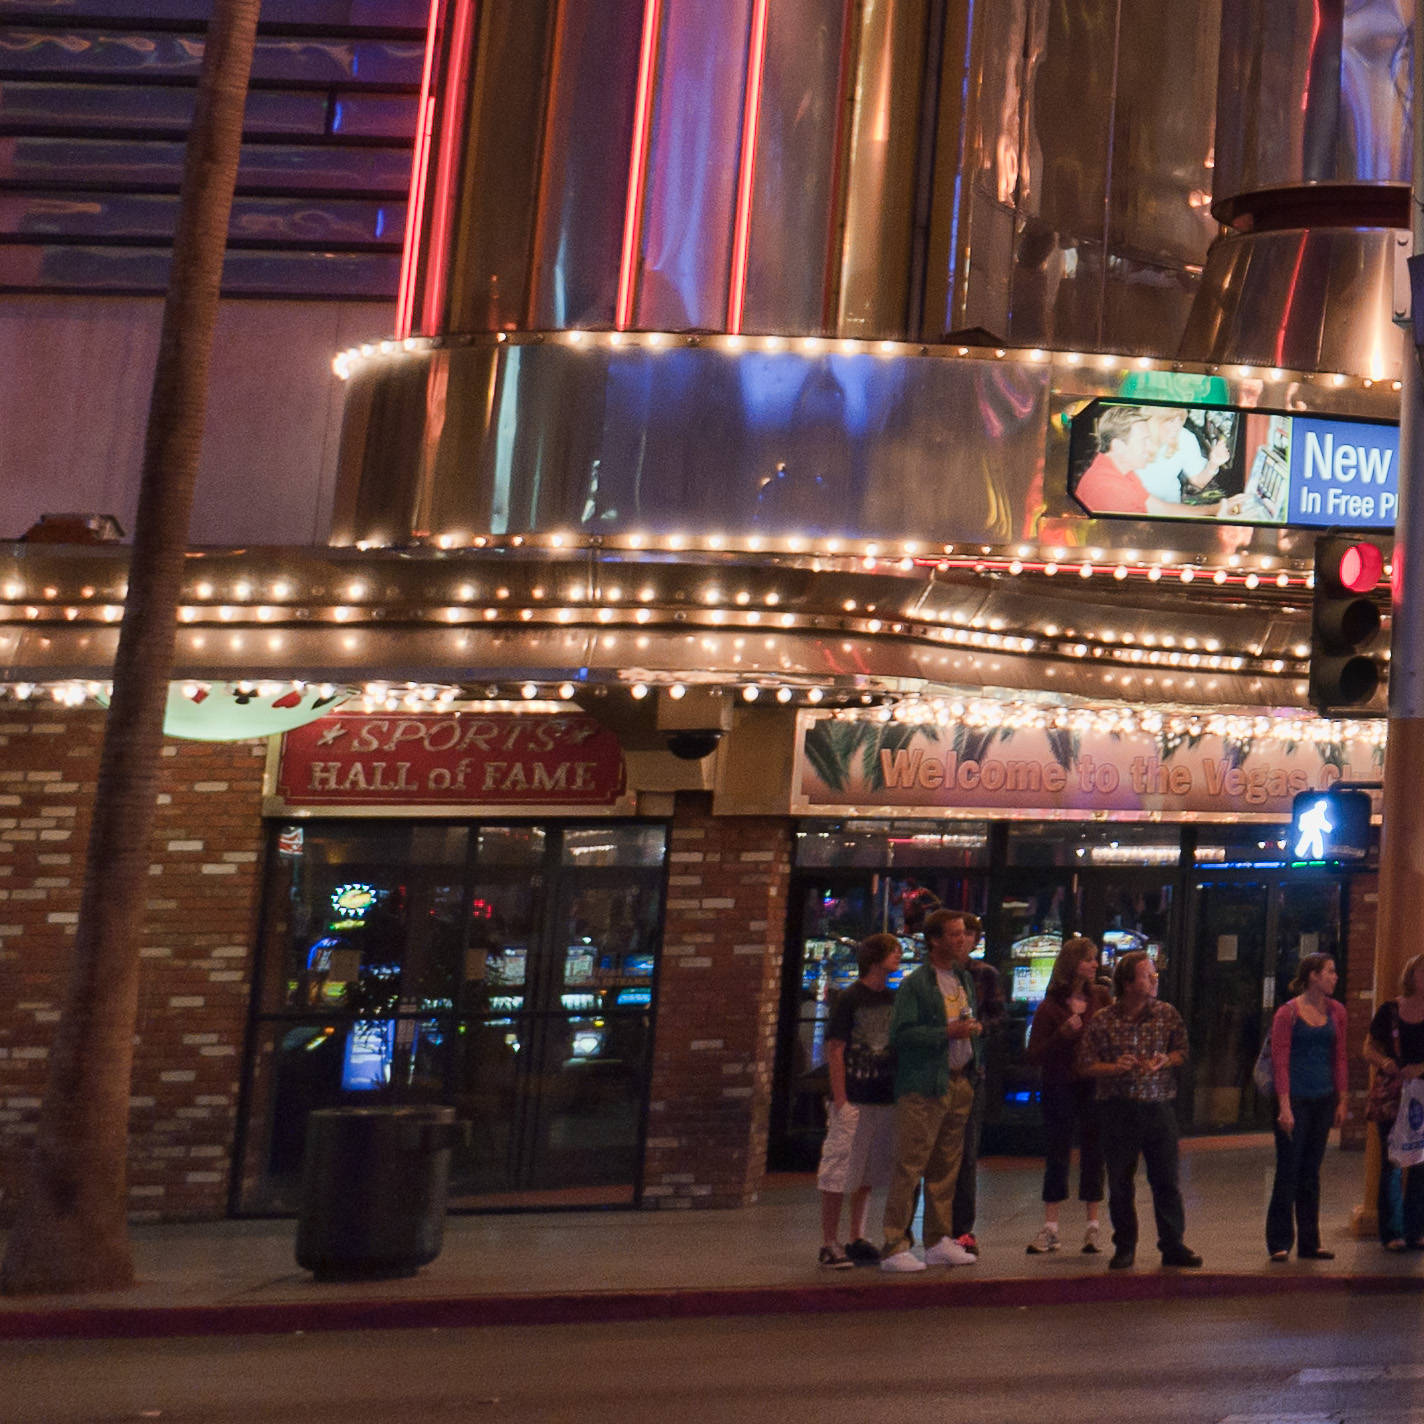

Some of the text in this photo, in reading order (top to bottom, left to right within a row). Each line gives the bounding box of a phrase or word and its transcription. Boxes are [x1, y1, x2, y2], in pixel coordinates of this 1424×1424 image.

[1303, 431, 1394, 485] New
[1300, 487, 1323, 513] In
[1327, 487, 1374, 518] Free
[350, 719, 567, 754] SPORTS
[307, 757, 598, 793] HALL of FAME
[880, 746, 1068, 794] Welcome
[1078, 753, 1119, 795] to
[1131, 755, 1192, 797] the
[1202, 756, 1308, 806] Vegas
